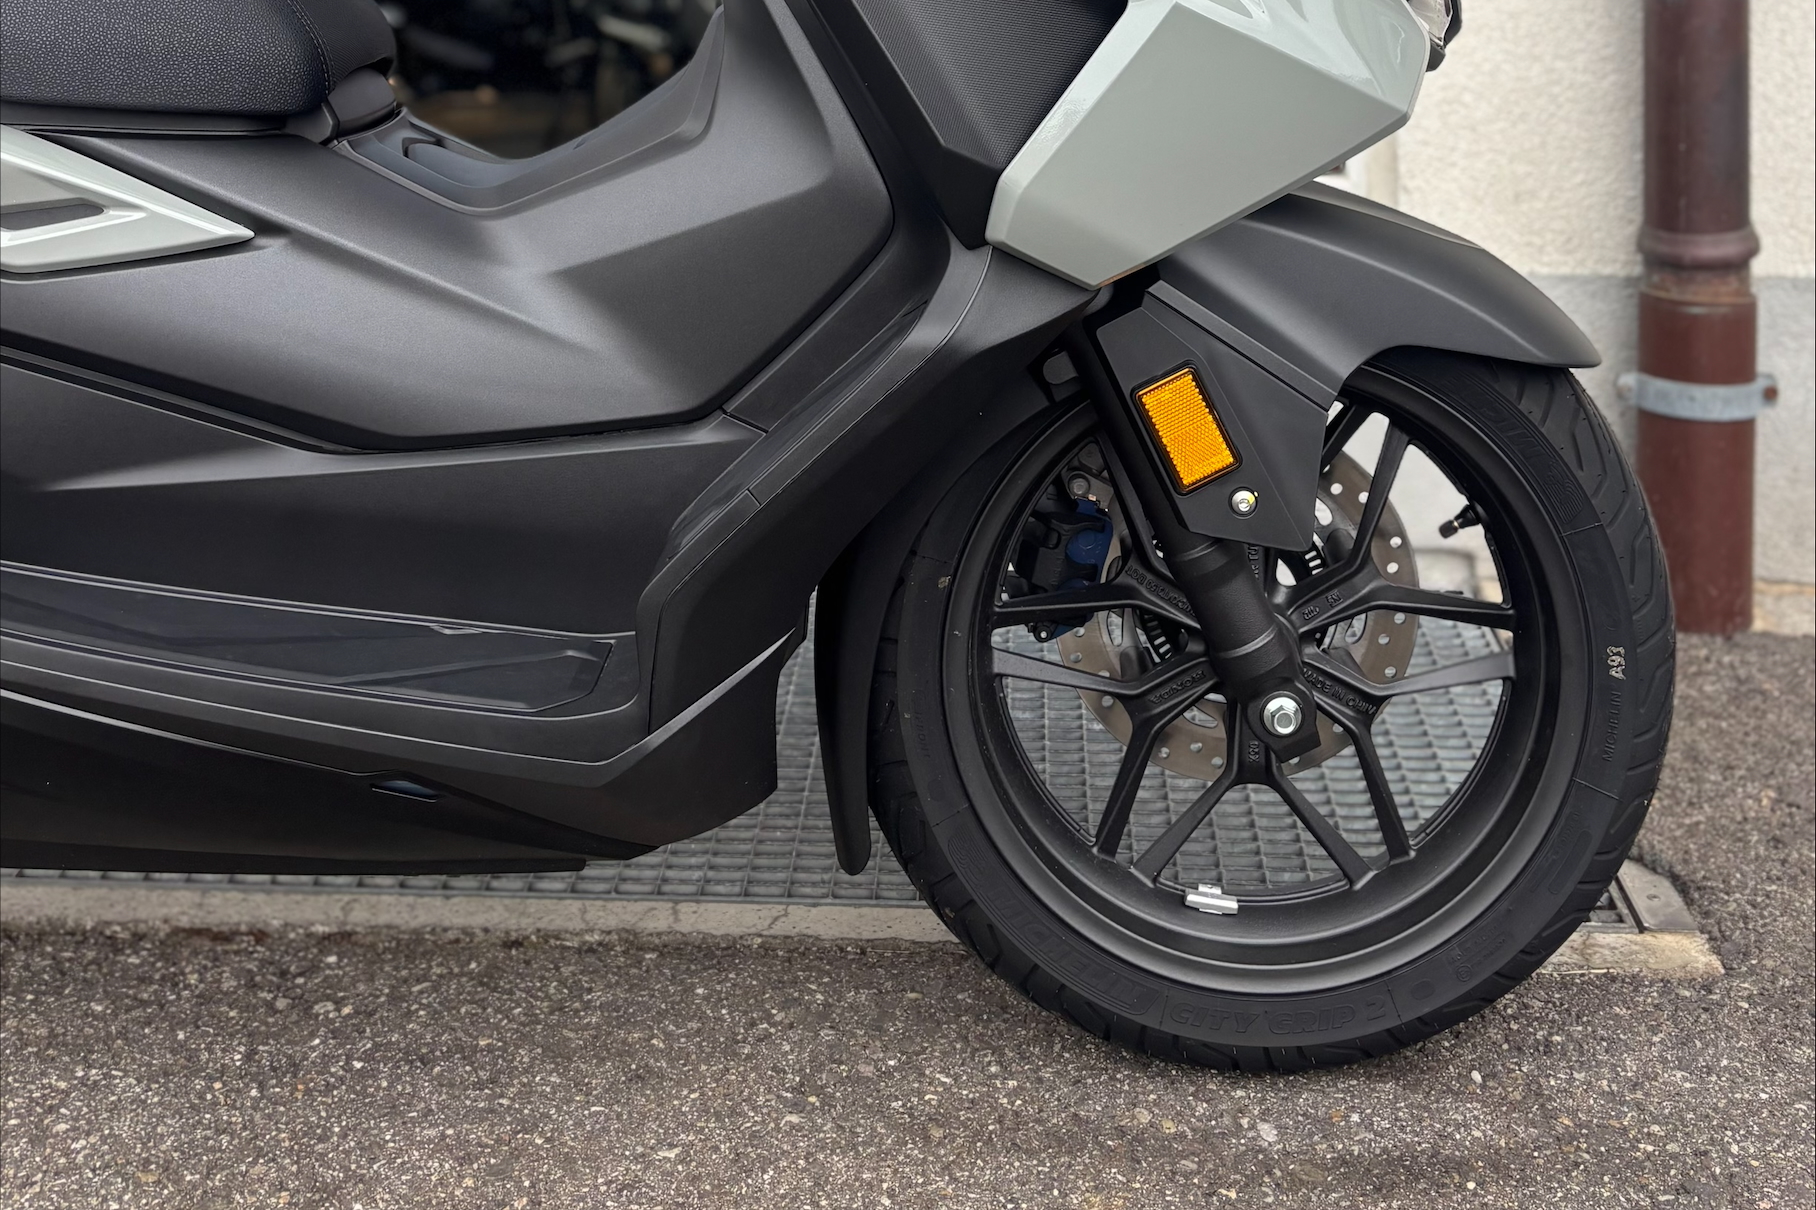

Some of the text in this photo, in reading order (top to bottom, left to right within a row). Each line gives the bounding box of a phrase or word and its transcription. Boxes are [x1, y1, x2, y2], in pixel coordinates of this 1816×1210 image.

[1606, 645, 1627, 681] A93
[1331, 686, 1346, 702] IN
[1169, 994, 1388, 1035] CITY GRIP 2
